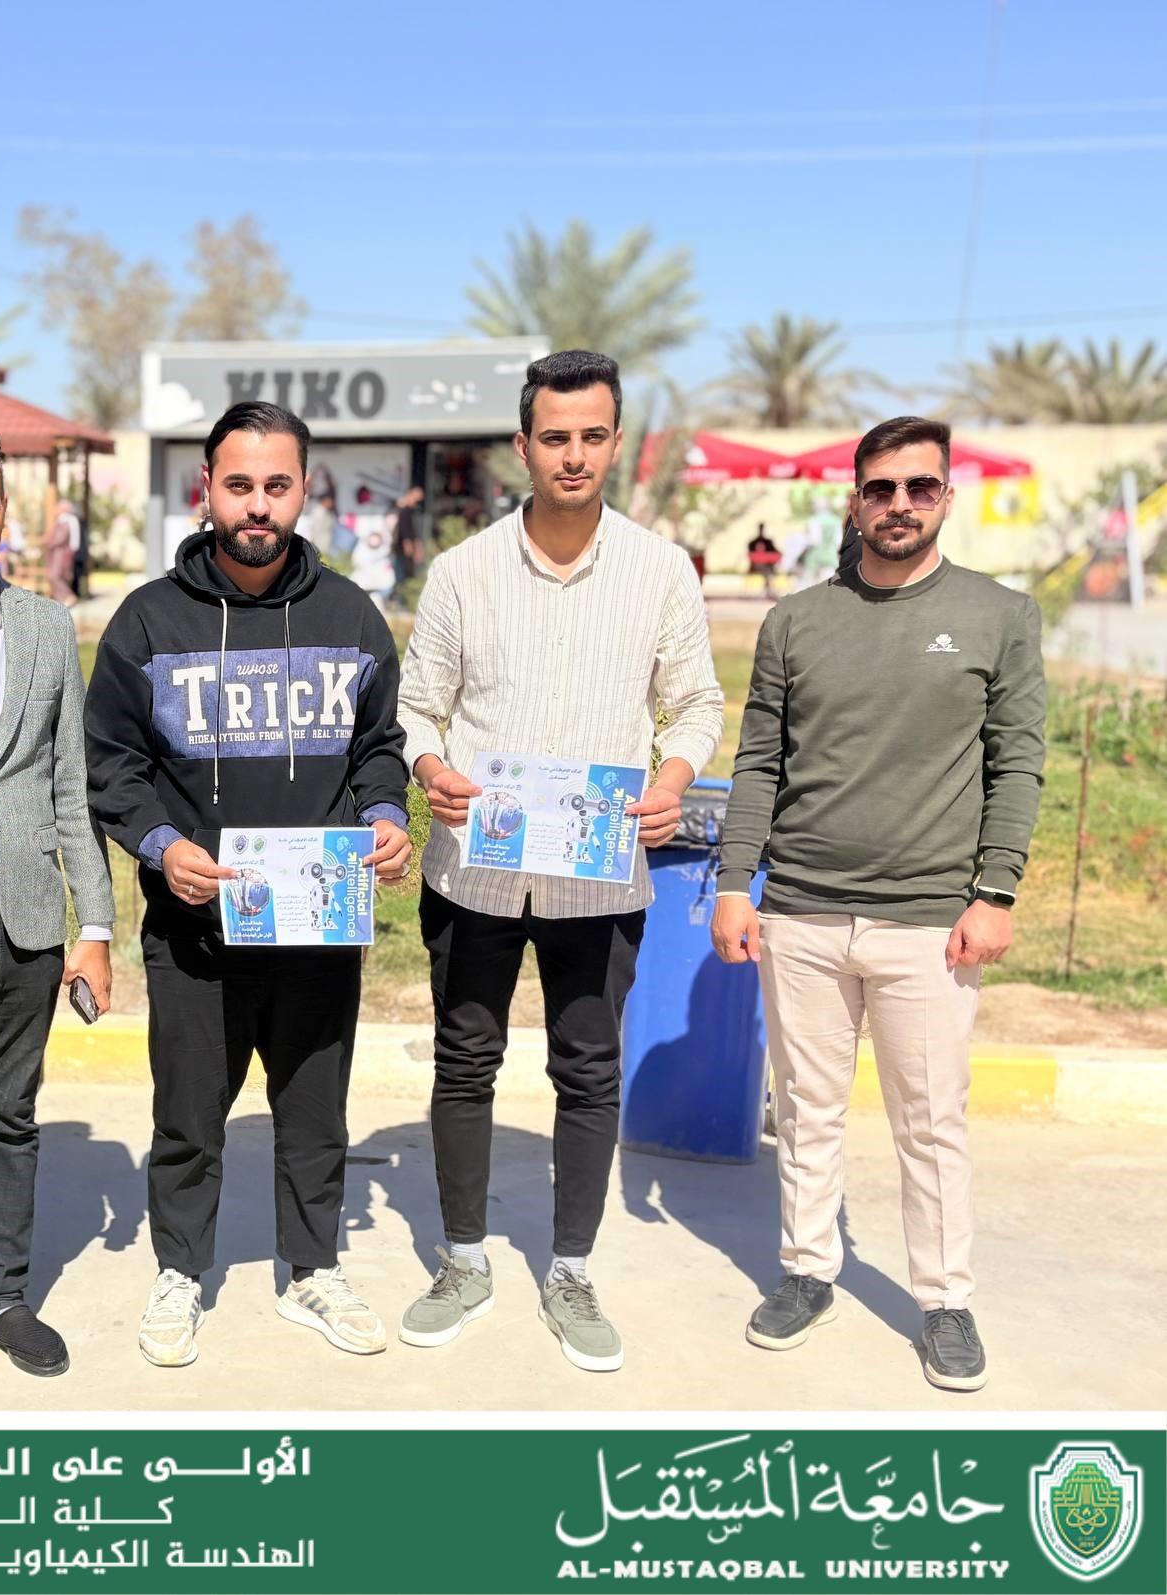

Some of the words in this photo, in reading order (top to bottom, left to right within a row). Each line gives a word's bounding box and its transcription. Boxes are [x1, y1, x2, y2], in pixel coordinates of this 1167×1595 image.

[226, 370, 387, 420] KIKO
[172, 662, 358, 732] TRICK
[259, 730, 284, 741] FROM
[312, 729, 331, 739] REAL
[604, 799, 624, 874] Intelligence
[344, 862, 358, 938] Intelligence
